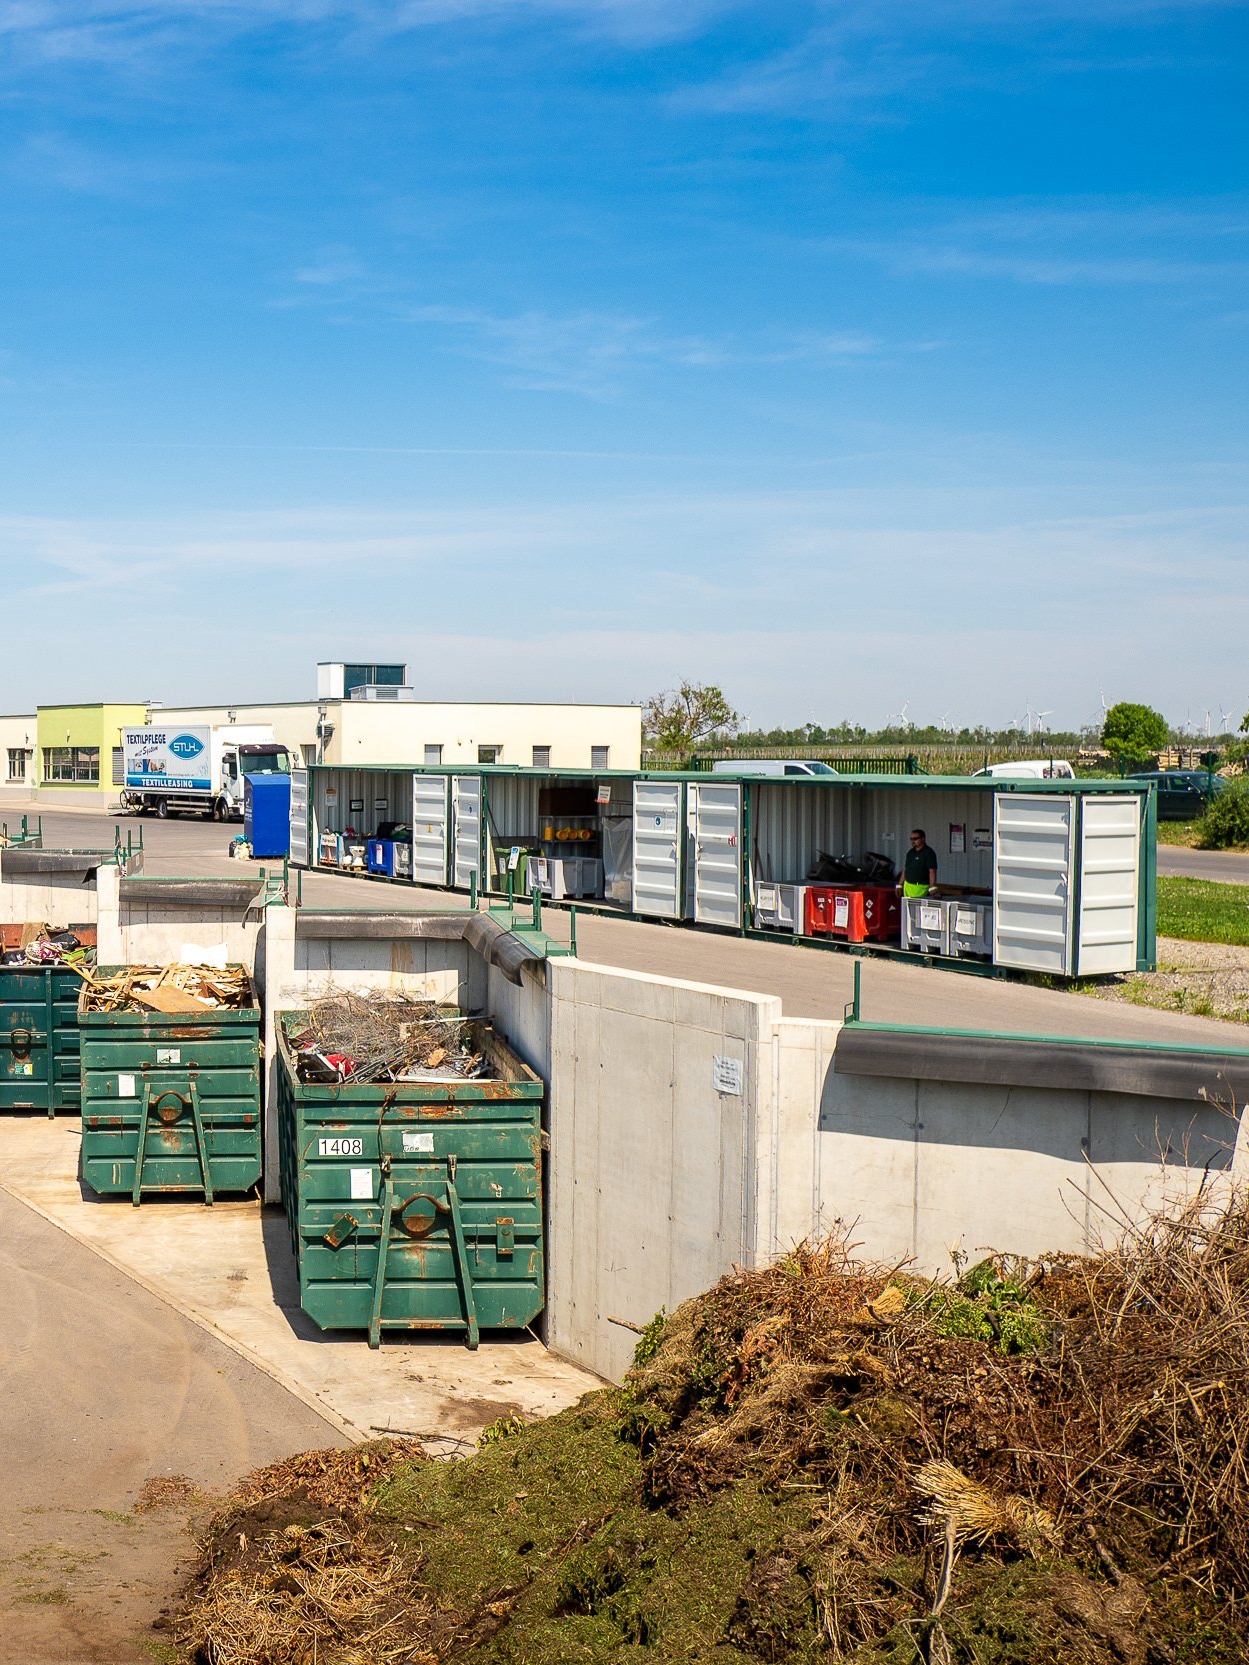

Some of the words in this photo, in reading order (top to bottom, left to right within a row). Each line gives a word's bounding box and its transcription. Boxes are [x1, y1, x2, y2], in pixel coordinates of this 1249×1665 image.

[127, 734, 166, 744] TEXTILPFLEGE
[141, 778, 193, 788] TEXTILLEASING
[321, 1139, 361, 1155] 1408
